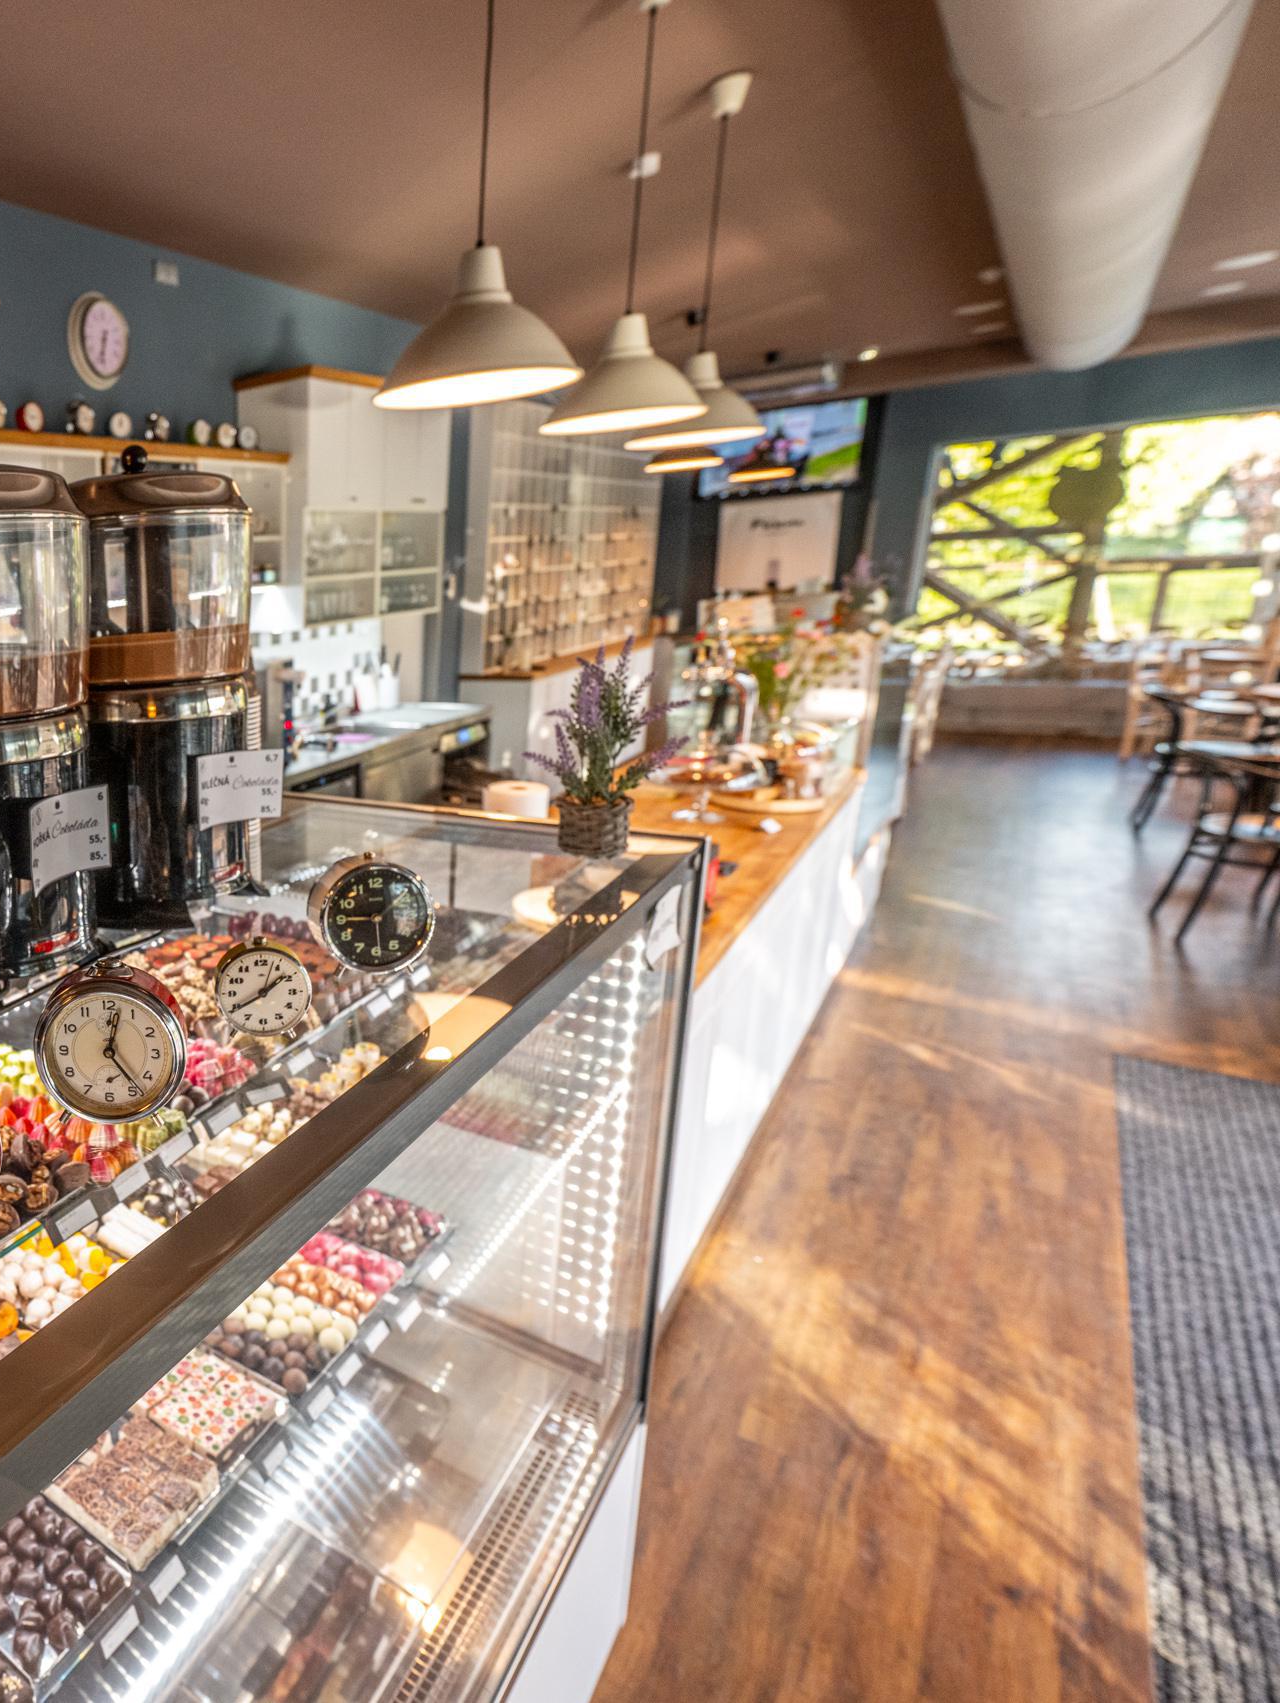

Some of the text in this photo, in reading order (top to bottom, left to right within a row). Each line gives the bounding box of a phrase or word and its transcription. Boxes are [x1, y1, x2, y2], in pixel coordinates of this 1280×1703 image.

[265, 754, 278, 763] 6,7
[97, 792, 104, 801] 6
[89, 834, 106, 844] 55,-
[89, 851, 107, 861] 85,-
[368, 877, 383, 889] 12
[352, 884, 364, 894] 11
[339, 899, 355, 909] 10
[336, 915, 347, 925] 9
[341, 931, 352, 941] 8
[354, 942, 365, 953] 7
[388, 940, 399, 950] 5
[371, 946, 381, 956] 6
[229, 977, 244, 985] 10
[102, 1000, 116, 1011] 12
[80, 1007, 89, 1017] 11
[130, 1009, 135, 1020] 1
[64, 1023, 77, 1034] 10
[145, 1027, 155, 1038] 2
[58, 1045, 69, 1056] 9
[151, 1049, 160, 1059] 3
[64, 1066, 75, 1078] 8
[142, 1070, 153, 1081] 4
[83, 1085, 93, 1095] 7
[128, 1086, 137, 1097] 5
[105, 1092, 115, 1103] 6
